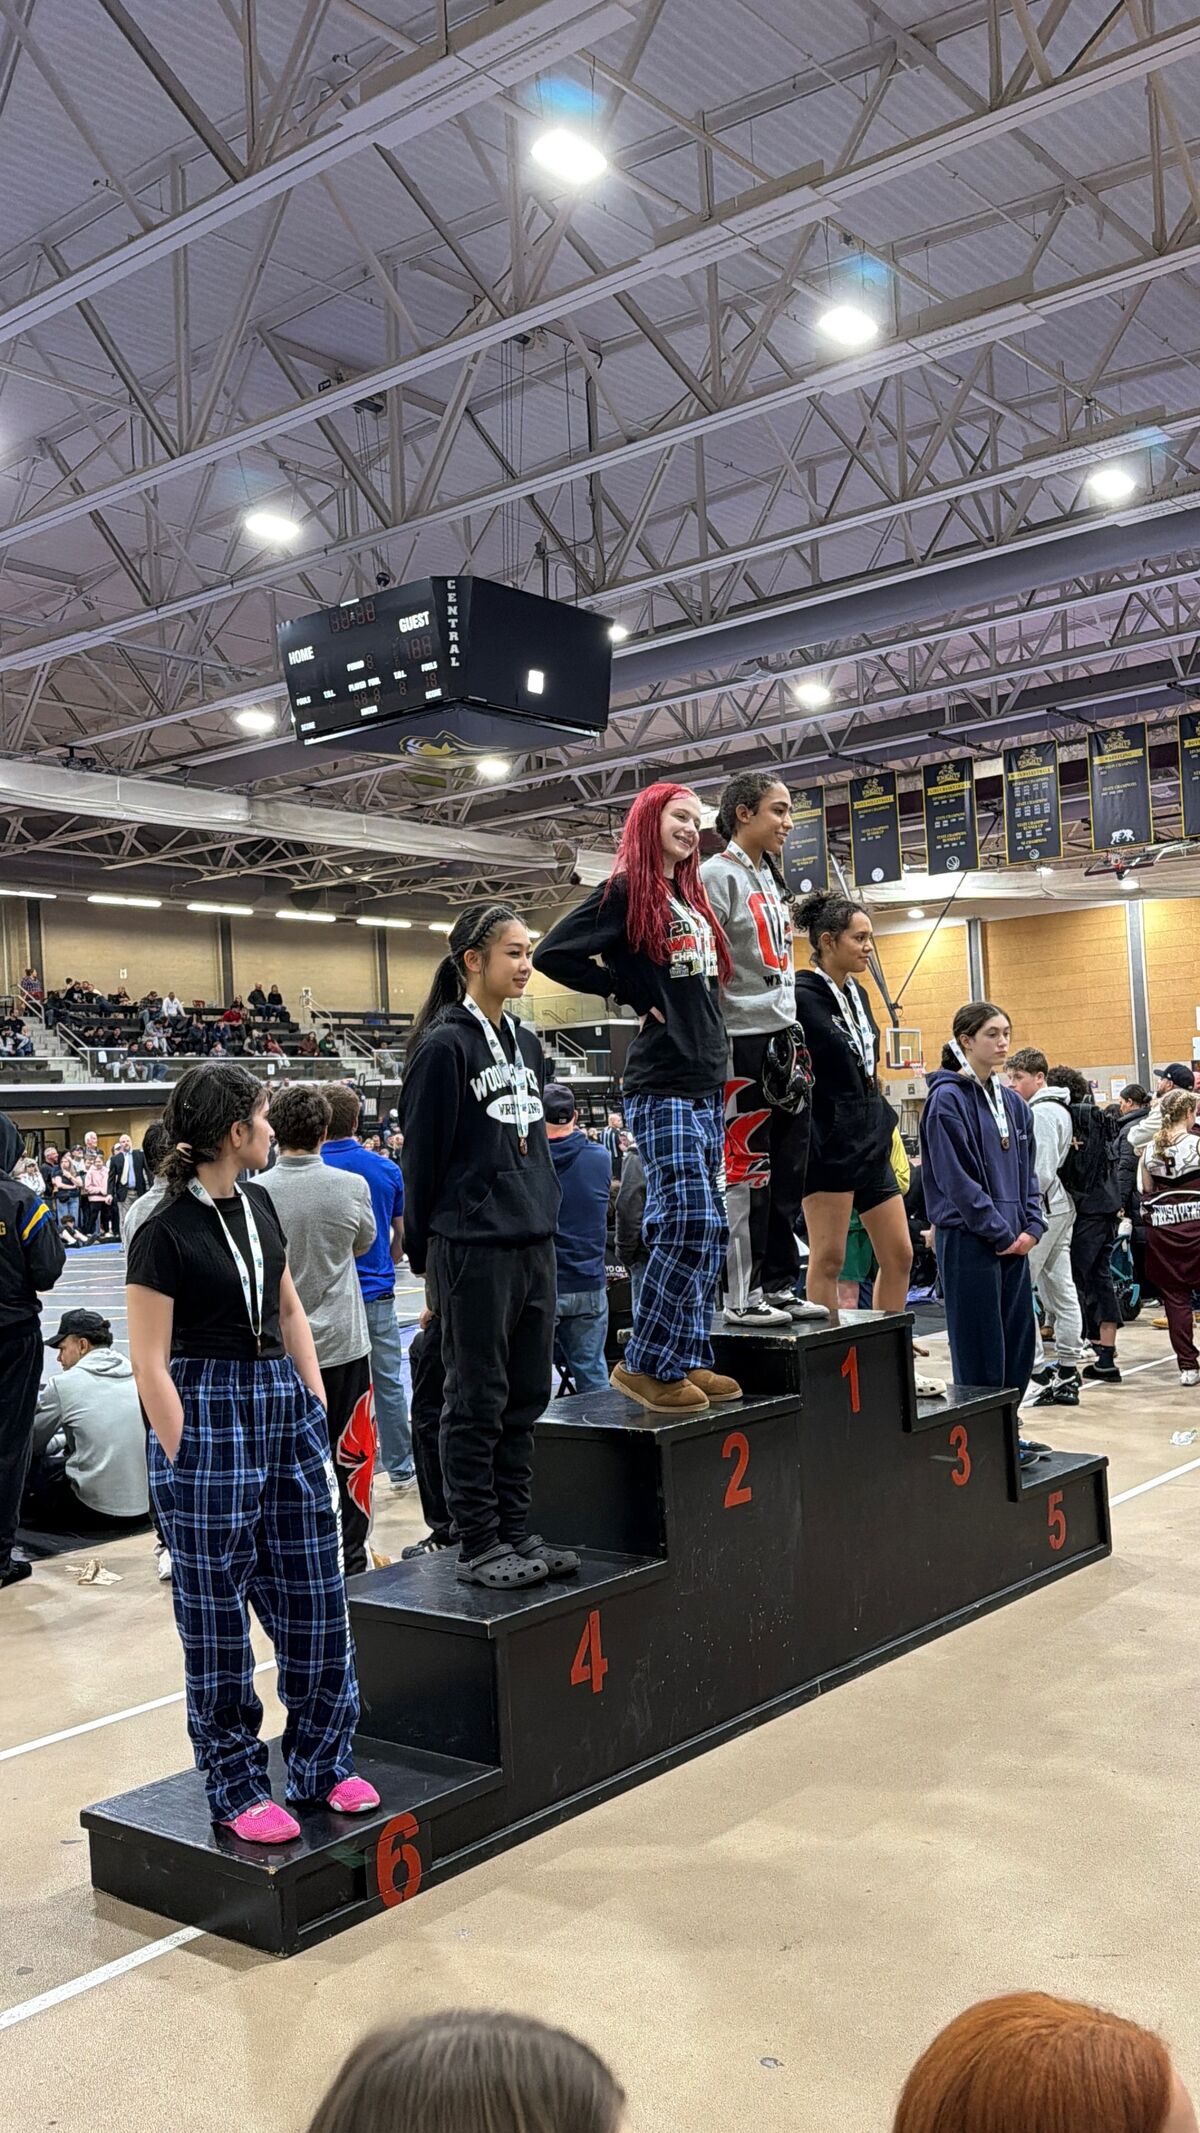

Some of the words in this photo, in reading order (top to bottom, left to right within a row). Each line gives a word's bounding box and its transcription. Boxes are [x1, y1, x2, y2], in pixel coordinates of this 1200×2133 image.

[398, 611, 430, 633] GUEST
[446, 579, 460, 667] CENTRAL
[288, 646, 315, 666] HOME
[841, 1346, 861, 1413] 1
[722, 1432, 753, 1508] 2
[948, 1425, 971, 1486] 3
[1046, 1491, 1068, 1550] 5
[570, 1610, 608, 1693] 4
[376, 1812, 422, 1909] 6
